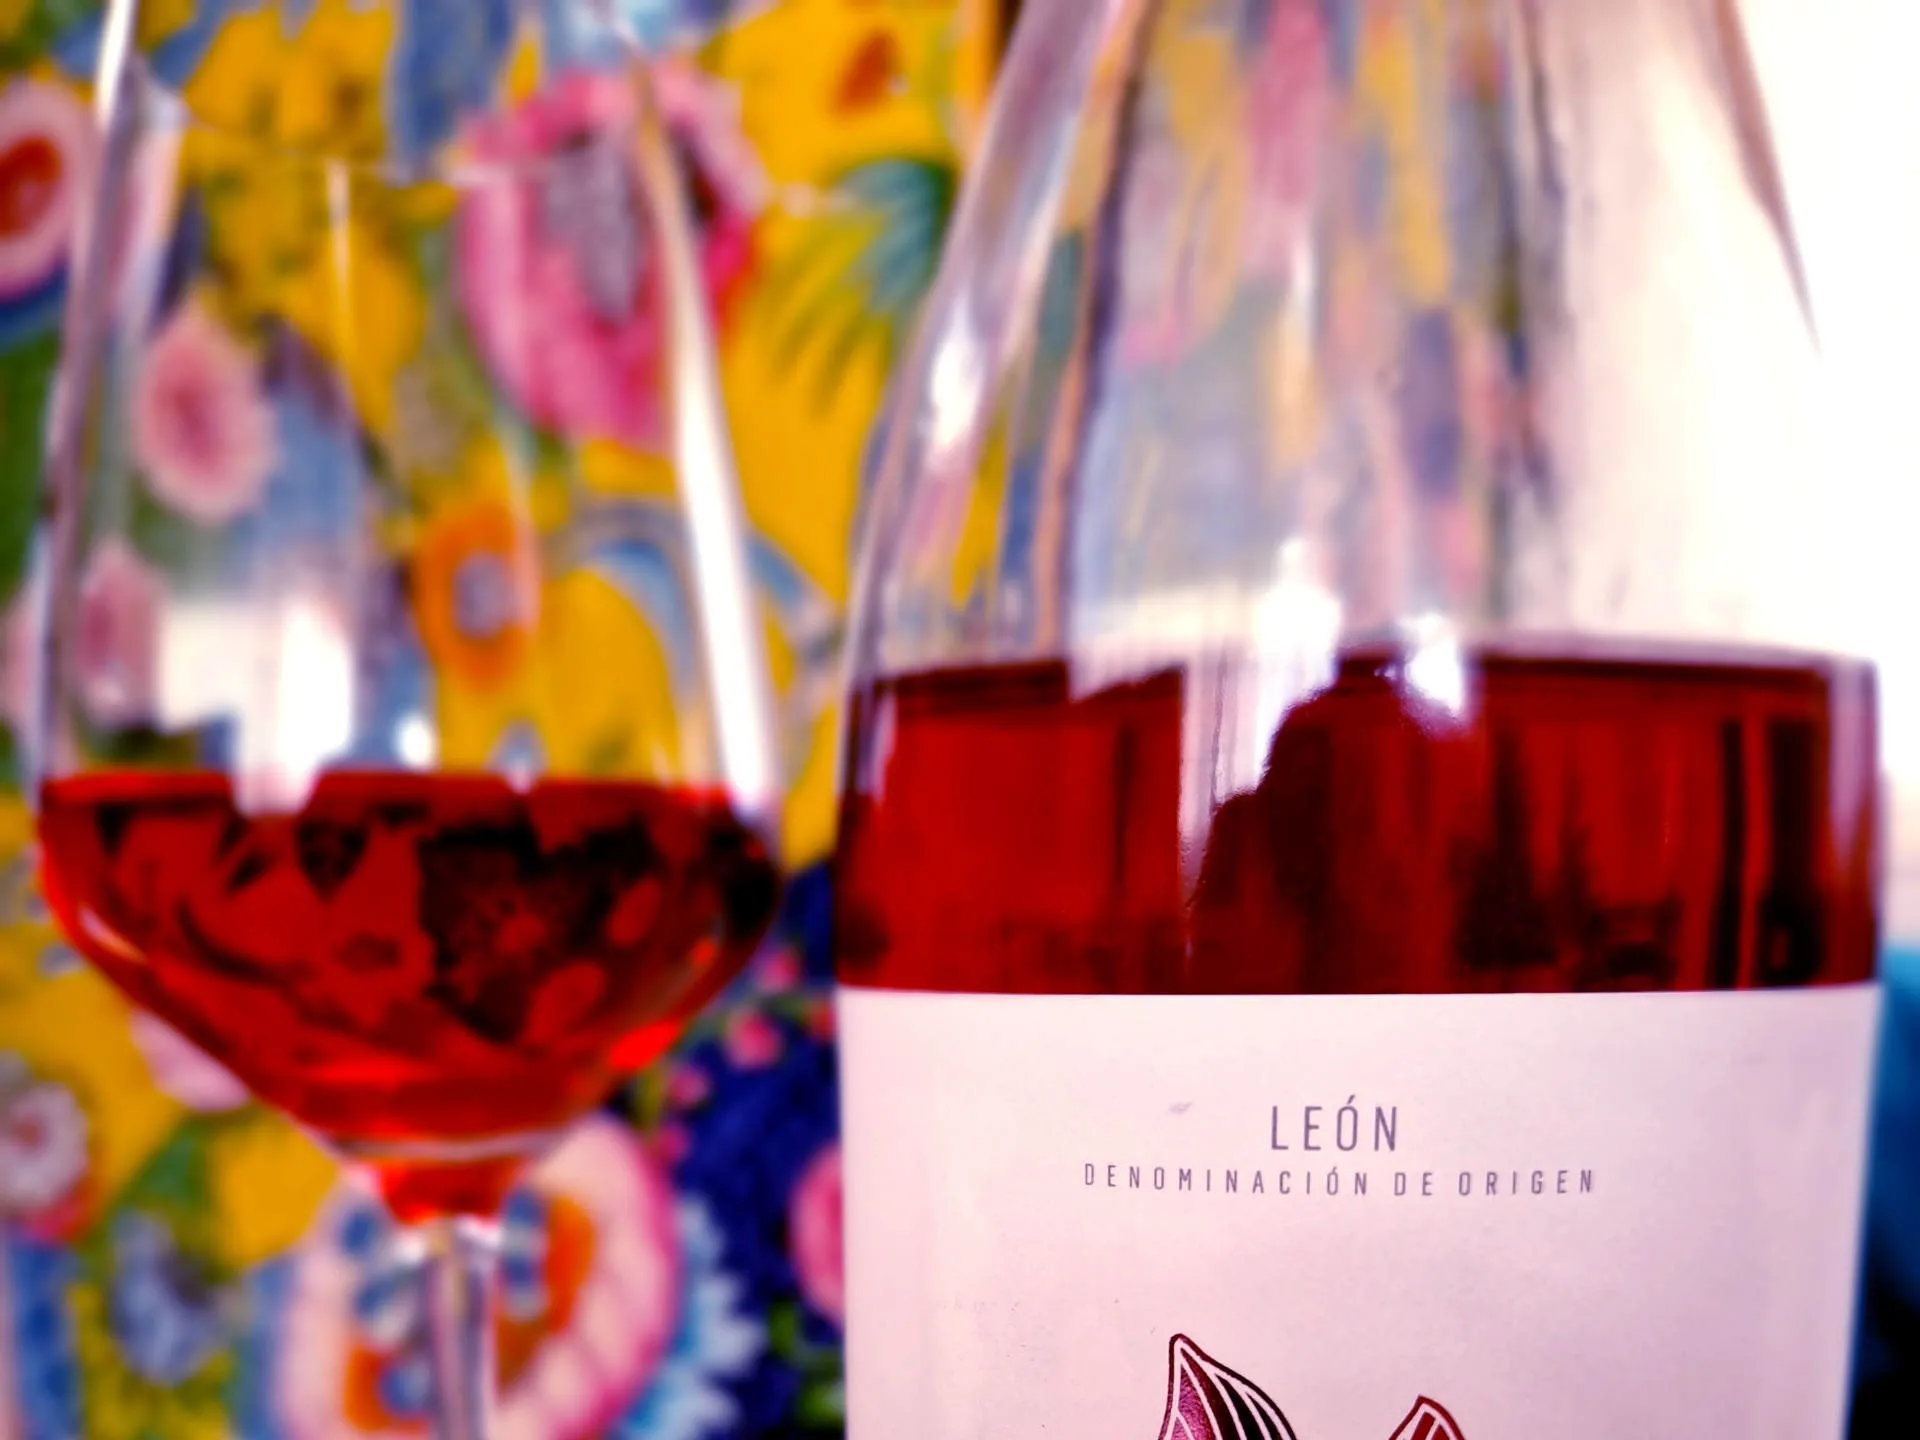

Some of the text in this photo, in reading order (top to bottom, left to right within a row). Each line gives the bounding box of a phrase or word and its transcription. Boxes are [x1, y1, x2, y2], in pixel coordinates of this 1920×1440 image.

[1270, 1093, 1398, 1151] LEÓN
[1084, 1162, 1593, 1196] DENOMINACIÓN DE ORIGEN
